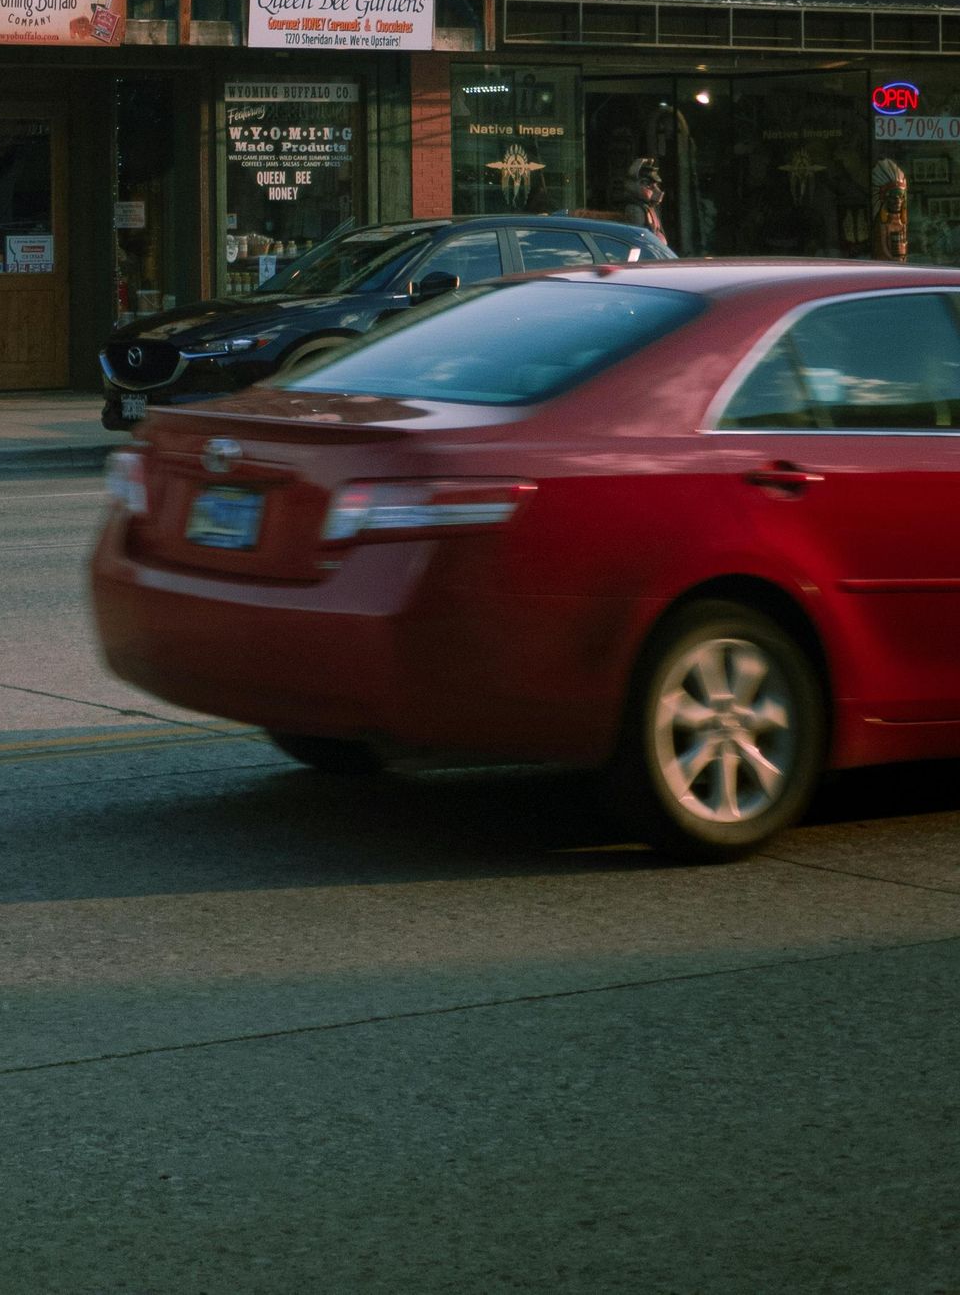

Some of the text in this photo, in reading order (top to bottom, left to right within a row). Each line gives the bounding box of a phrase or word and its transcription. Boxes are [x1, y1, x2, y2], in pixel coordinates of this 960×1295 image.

[8, 14, 51, 27] COMPANY
[268, 17, 413, 33] Gourmet HONEY Caramels & Chocolates
[0, 31, 60, 42] wyobuffalo.com
[285, 33, 300, 44] 1270
[301, 33, 332, 45] Sheridan
[350, 35, 369, 46] We're
[370, 35, 401, 47] Upstairs!
[229, 86, 352, 99] WYOMING BUFFALO CO.
[872, 87, 919, 109] OPEN
[227, 105, 266, 124] Featuring
[469, 124, 564, 137] Native Images
[762, 128, 842, 140] Native Images
[876, 118, 944, 138] 30-70%
[235, 142, 347, 152] Made Products
[257, 171, 312, 186] QUEEN BEE
[269, 187, 298, 201] HONEY
